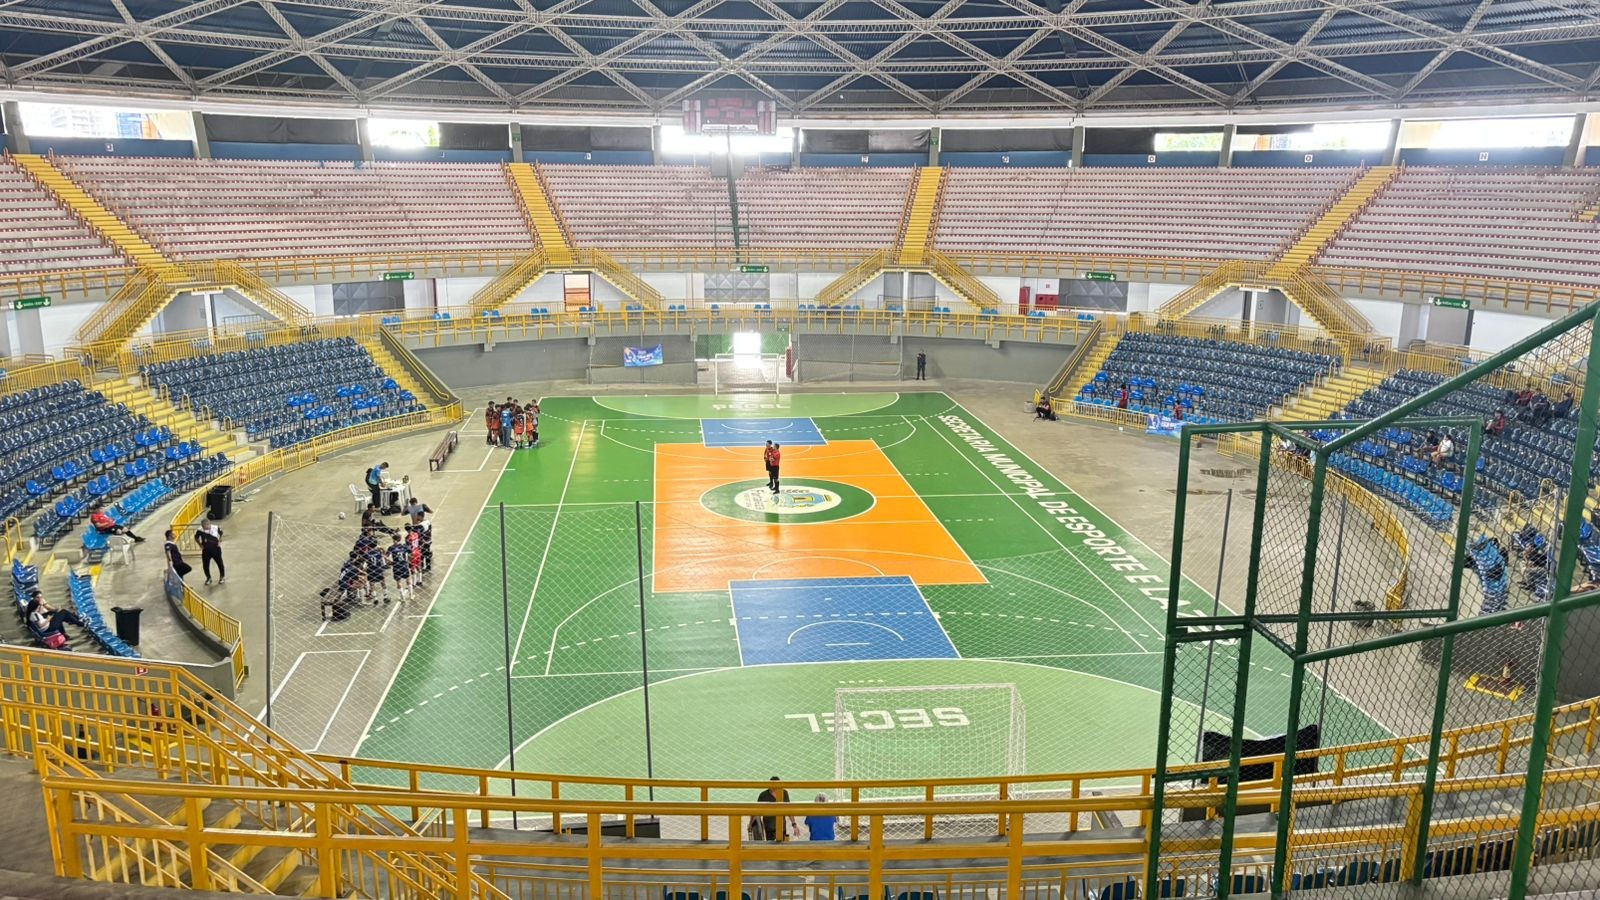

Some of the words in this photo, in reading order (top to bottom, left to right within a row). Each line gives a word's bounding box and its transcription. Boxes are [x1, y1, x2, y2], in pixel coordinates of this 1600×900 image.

[938, 415, 999, 453] SECRETARIA
[982, 453, 1056, 499] MUNICIPAL
[1037, 501, 1079, 515] DE
[1055, 516, 1149, 572] ESPORTE
[1124, 574, 1164, 583] E
[784, 707, 970, 733] SECEL
